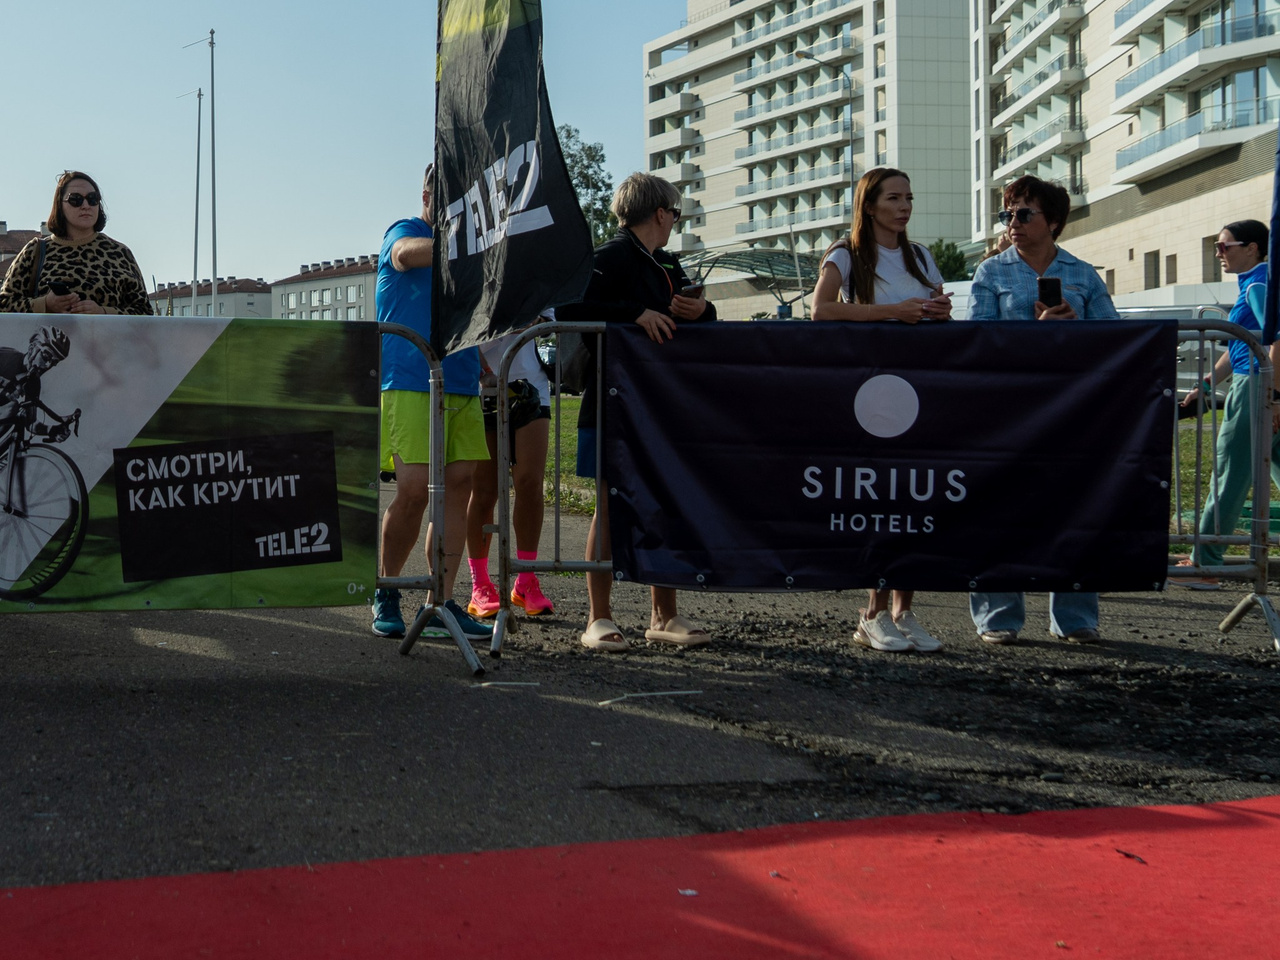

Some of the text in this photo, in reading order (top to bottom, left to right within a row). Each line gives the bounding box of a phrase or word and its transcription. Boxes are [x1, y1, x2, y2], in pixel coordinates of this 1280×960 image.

[447, 140, 555, 261] TELE2
[126, 450, 252, 482] СМОТРИ,
[801, 466, 967, 502] SIRIUS
[129, 474, 301, 512] КАК КРУТИТ
[255, 522, 331, 558] TELE2
[830, 513, 935, 534] HOTELS
[347, 582, 366, 595] 0+
